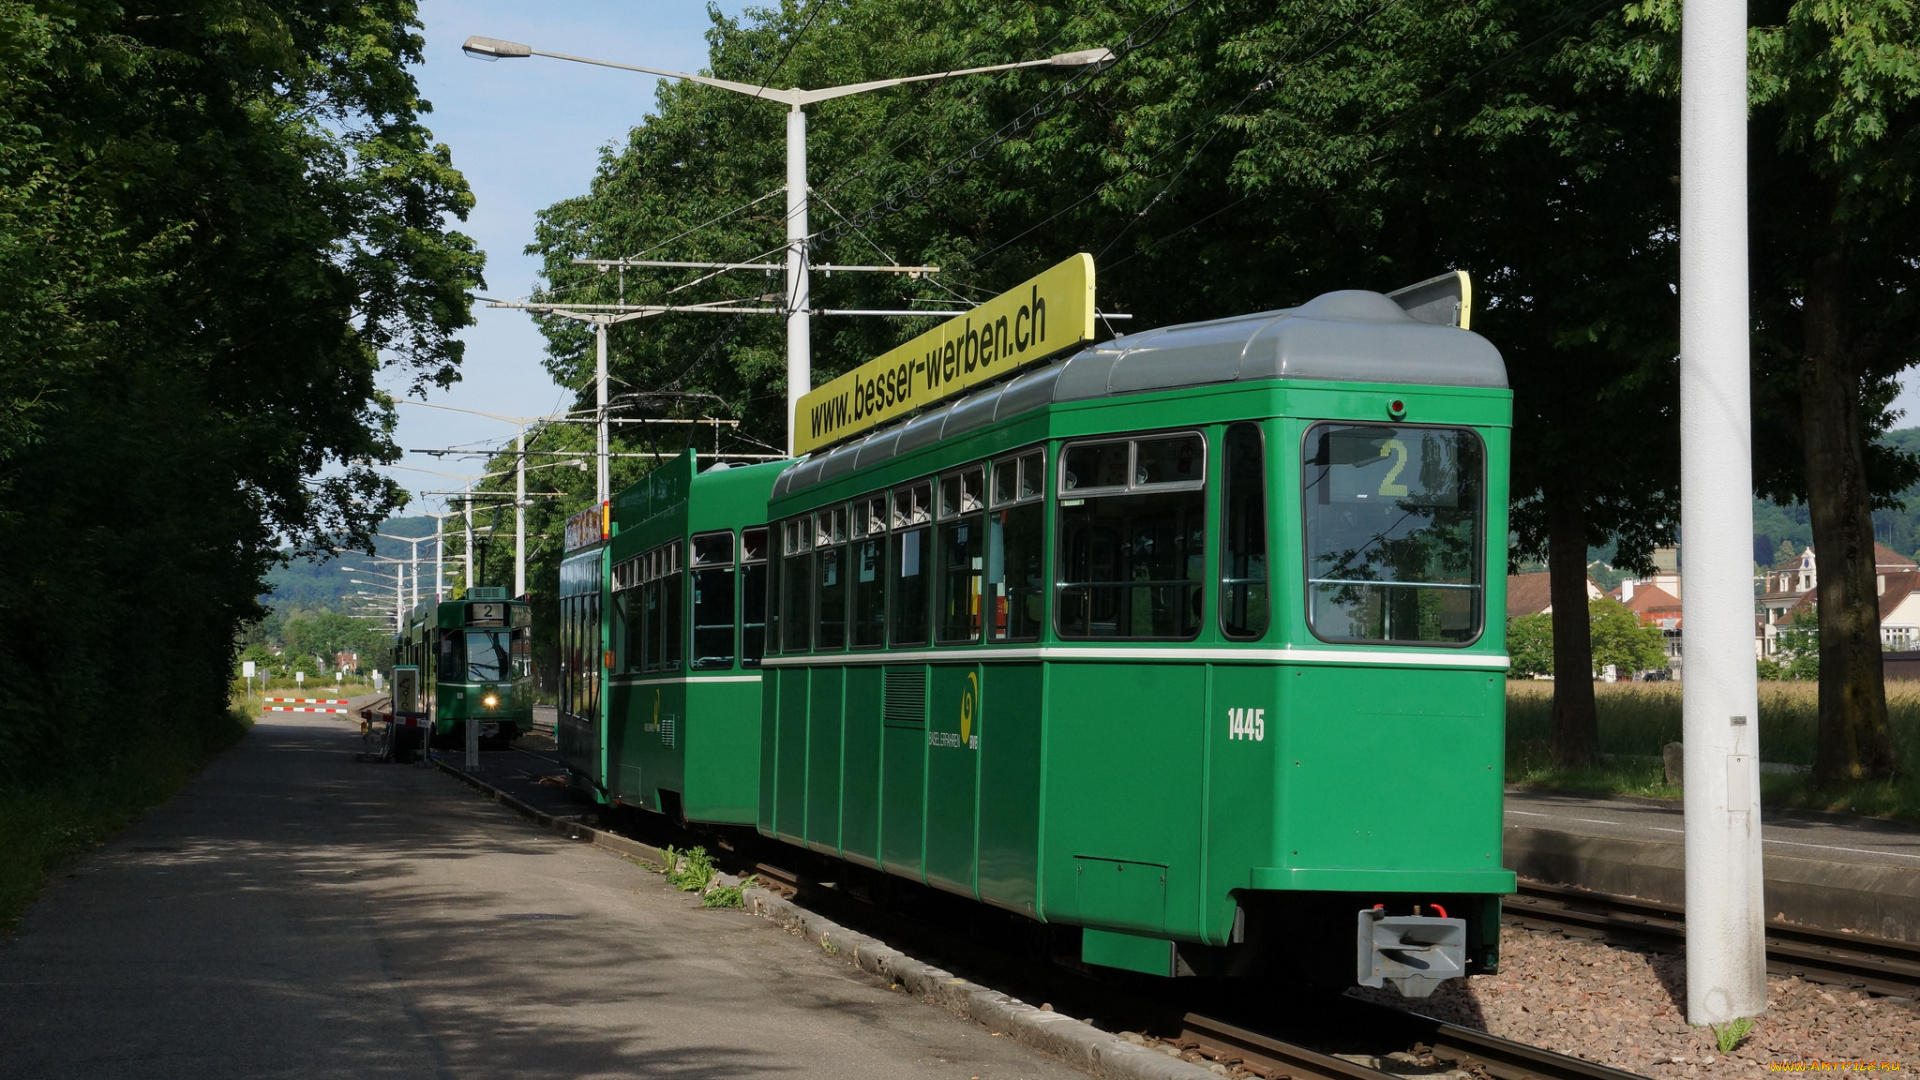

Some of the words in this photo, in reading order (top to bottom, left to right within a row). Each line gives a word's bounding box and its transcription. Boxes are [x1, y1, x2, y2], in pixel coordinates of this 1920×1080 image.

[811, 284, 1046, 439] www.besser-werben.ch
[1379, 439, 1408, 496] 2
[484, 605, 493, 618] 2
[1228, 707, 1265, 742] 1445
